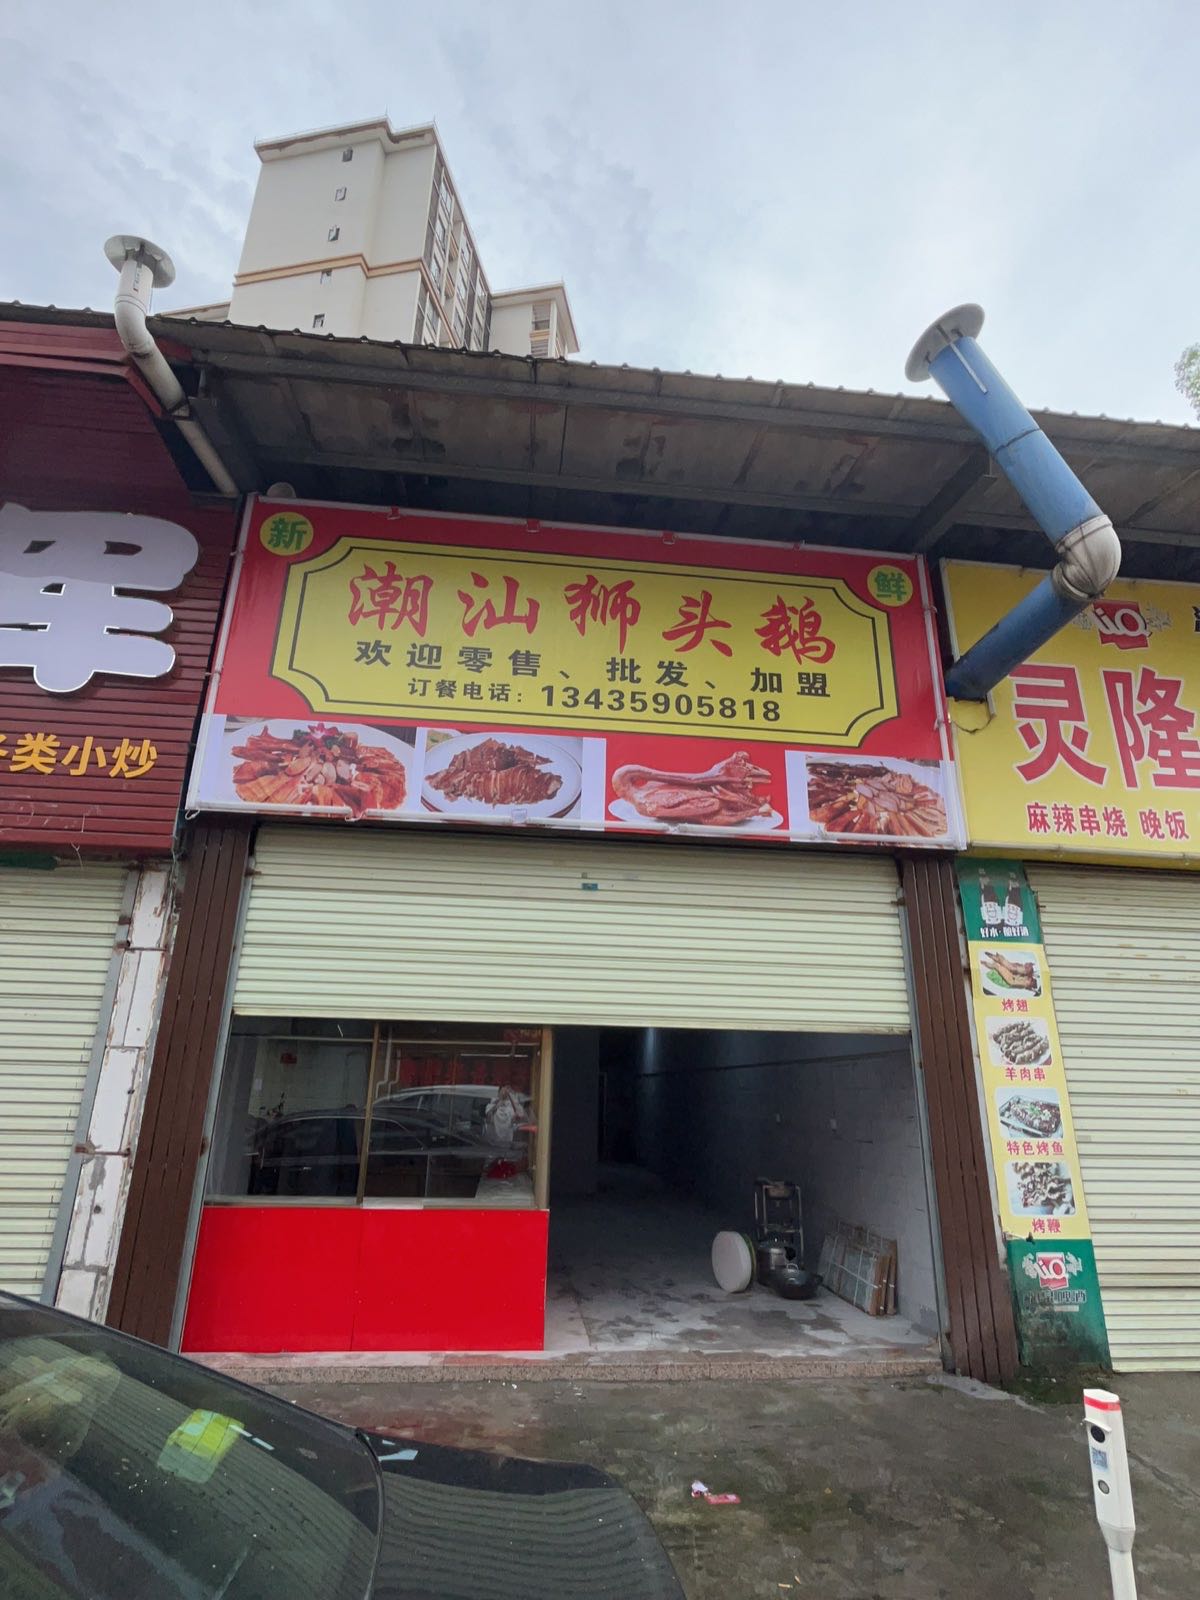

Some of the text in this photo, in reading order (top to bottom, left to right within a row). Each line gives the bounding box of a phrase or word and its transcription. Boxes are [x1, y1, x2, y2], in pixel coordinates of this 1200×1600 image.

[267, 517, 309, 550] 新
[873, 571, 907, 602] 鲜
[349, 561, 836, 664] 潮汕狮头鹅
[1026, 802, 1190, 840] 麻辣串烧 晚饭
[1001, 998, 1029, 1013] 烤翅
[1004, 1066, 1046, 1081] 羊肉串
[1006, 1141, 1065, 1157] 特色烤鱼
